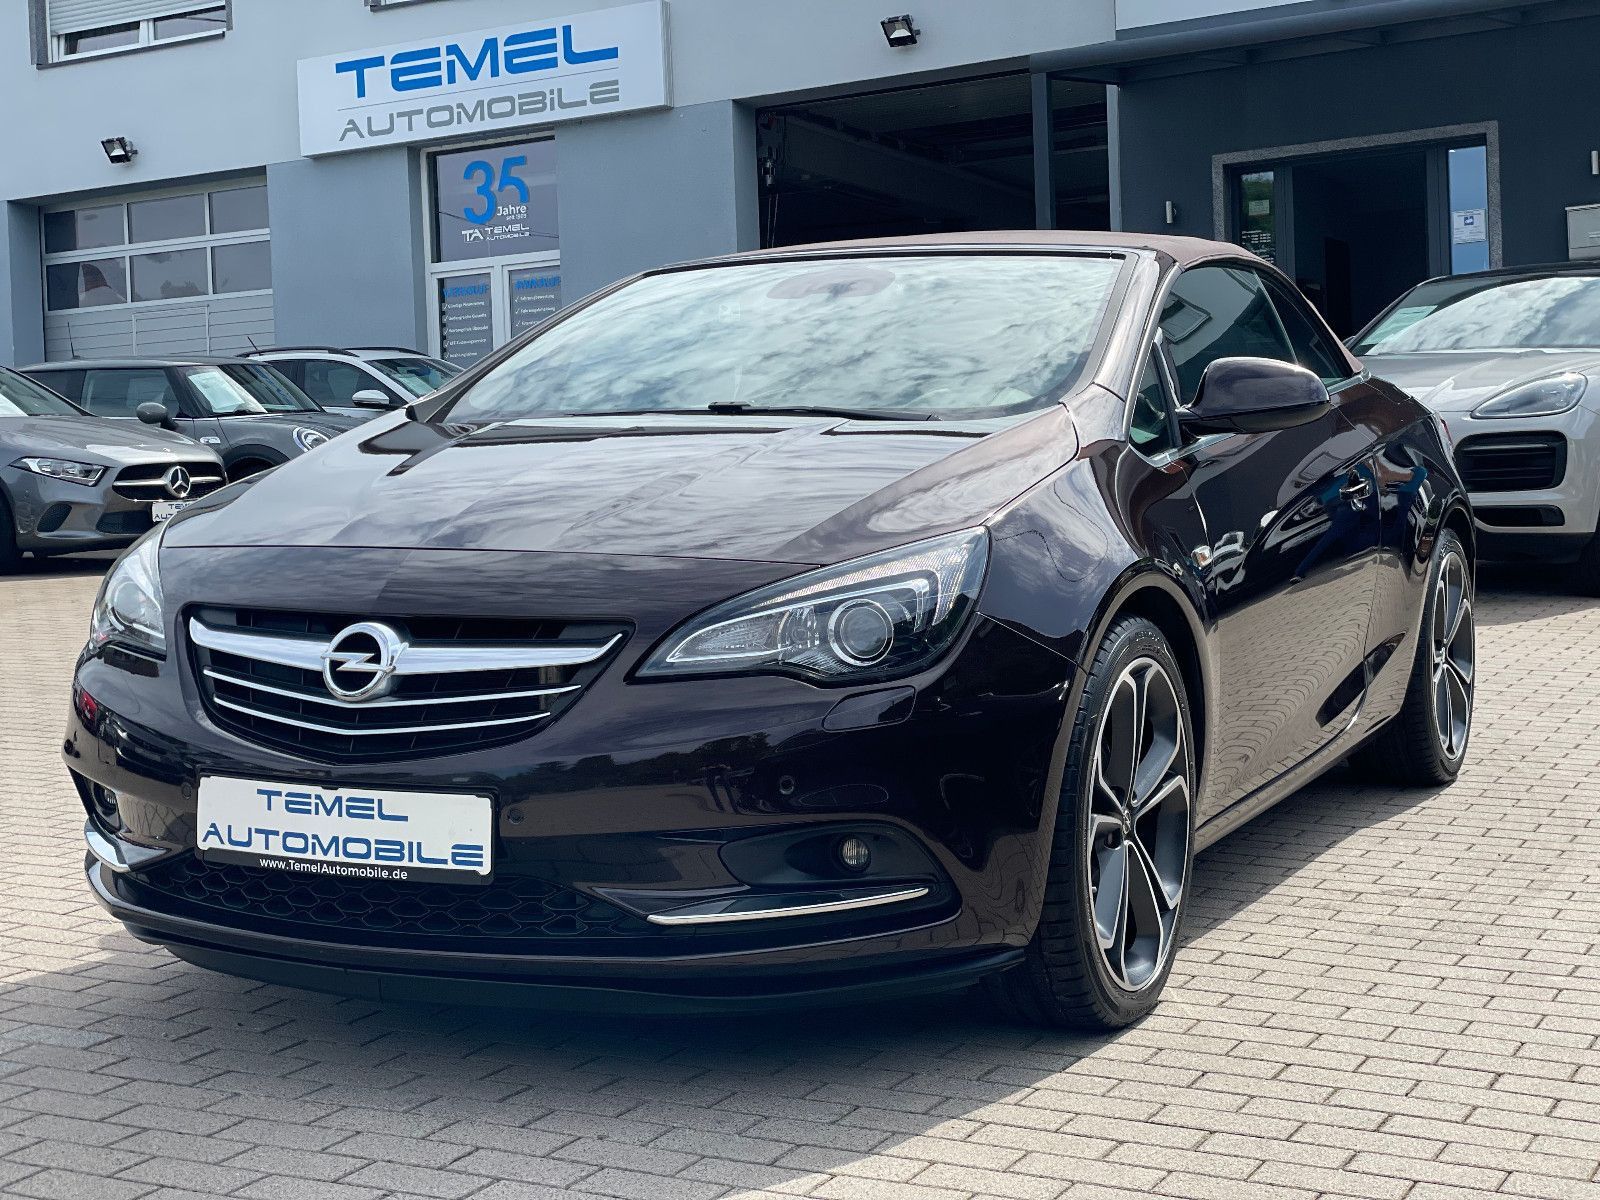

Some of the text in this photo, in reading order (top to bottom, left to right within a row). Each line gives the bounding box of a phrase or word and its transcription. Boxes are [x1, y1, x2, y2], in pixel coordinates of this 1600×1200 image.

[335, 24, 619, 98] TEMEL
[463, 155, 530, 225] 35
[497, 204, 527, 216] Jahre
[462, 228, 484, 242] TA
[485, 223, 530, 235] TEMEL
[257, 788, 409, 822] TEMEL
[202, 822, 484, 867] AUTOMOBILE
[259, 857, 408, 880] www.TemelAutomobile.de
